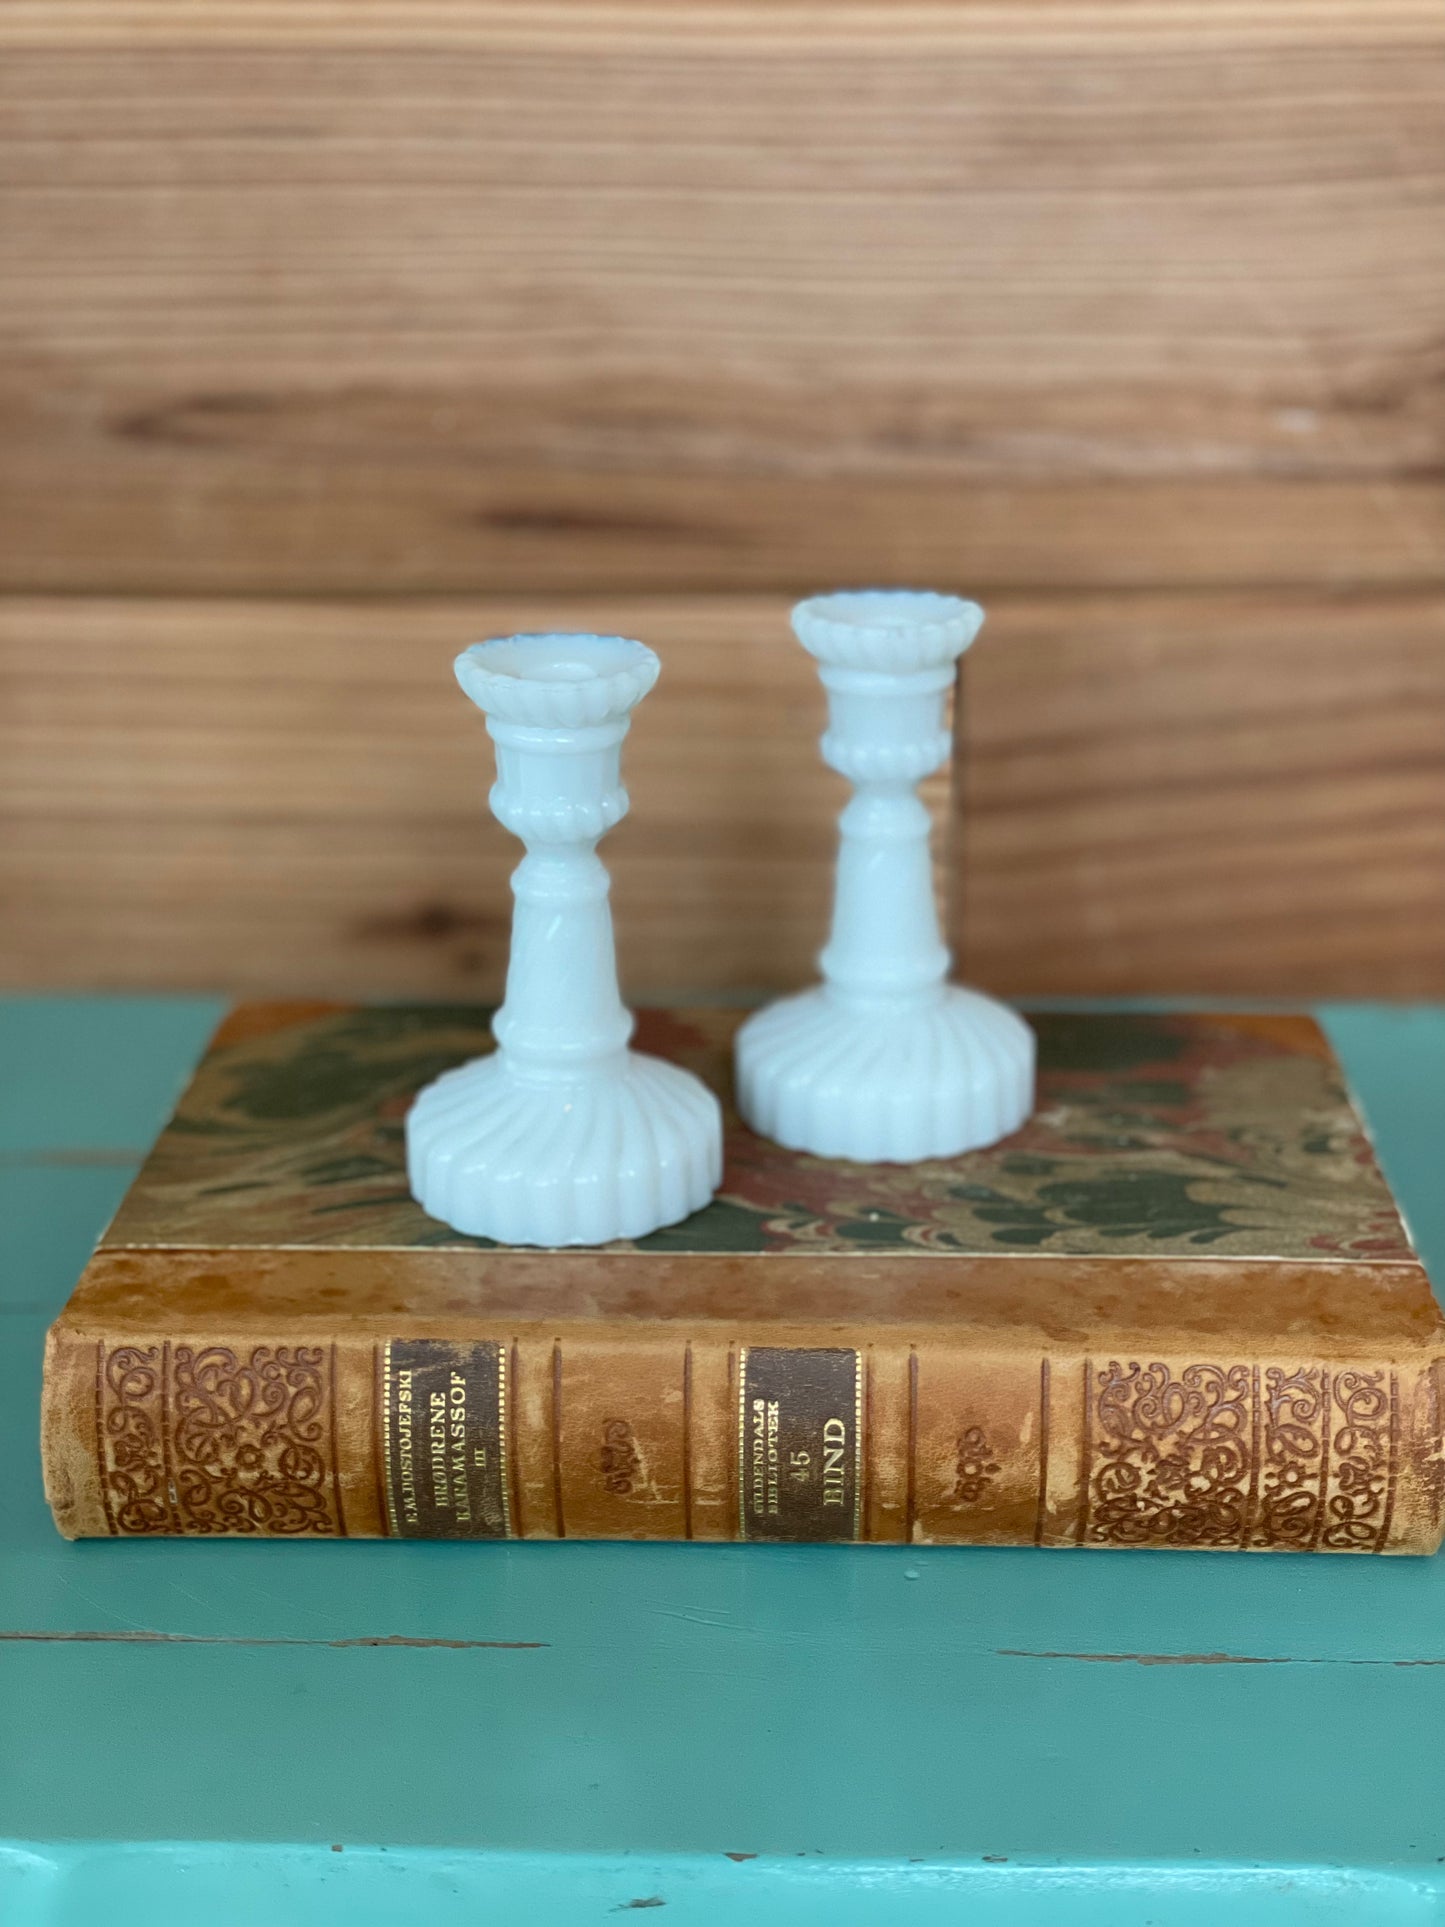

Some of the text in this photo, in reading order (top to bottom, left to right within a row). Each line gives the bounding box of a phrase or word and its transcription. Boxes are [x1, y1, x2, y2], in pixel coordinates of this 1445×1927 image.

[430, 1392, 449, 1507] BRØDRENE
[450, 1371, 471, 1521] KARAMASSOF
[753, 1398, 765, 1514] GYLDENDALS
[767, 1400, 780, 1515] BIBLIOTEK
[790, 1450, 811, 1482] 45
[823, 1417, 846, 1507] BIND
